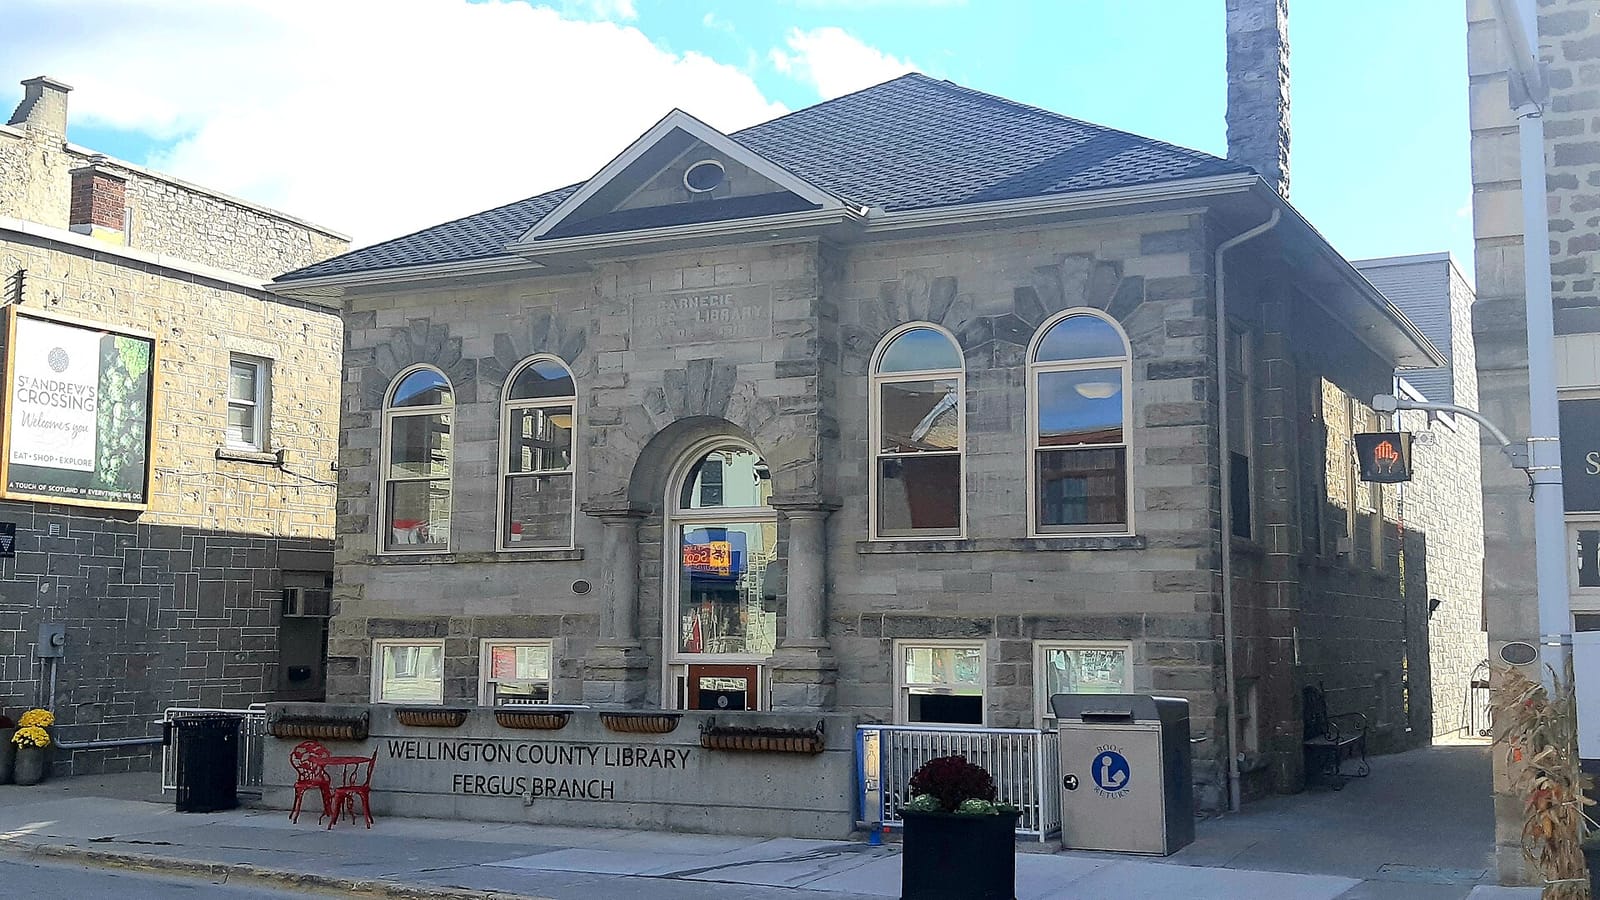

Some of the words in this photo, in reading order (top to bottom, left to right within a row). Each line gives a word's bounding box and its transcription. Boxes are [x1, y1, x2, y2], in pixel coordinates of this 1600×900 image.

[31, 378, 95, 398] ANDREW'S
[17, 388, 94, 412] CROSSING
[21, 410, 70, 432] Welcomes
[71, 423, 89, 440] you
[13, 451, 28, 460] EAT
[33, 453, 54, 462] SHOP
[59, 456, 93, 467] EXPLORE
[15, 482, 37, 490] TOUCH
[48, 485, 79, 494] SCOTLAND
[388, 740, 511, 763] WELLINGTON
[516, 744, 600, 766] COUNTY
[604, 747, 691, 769] LIBRARY
[452, 774, 526, 796] FERGUS
[531, 777, 614, 799] BRANCH
[1094, 787, 1130, 799] RETURN
